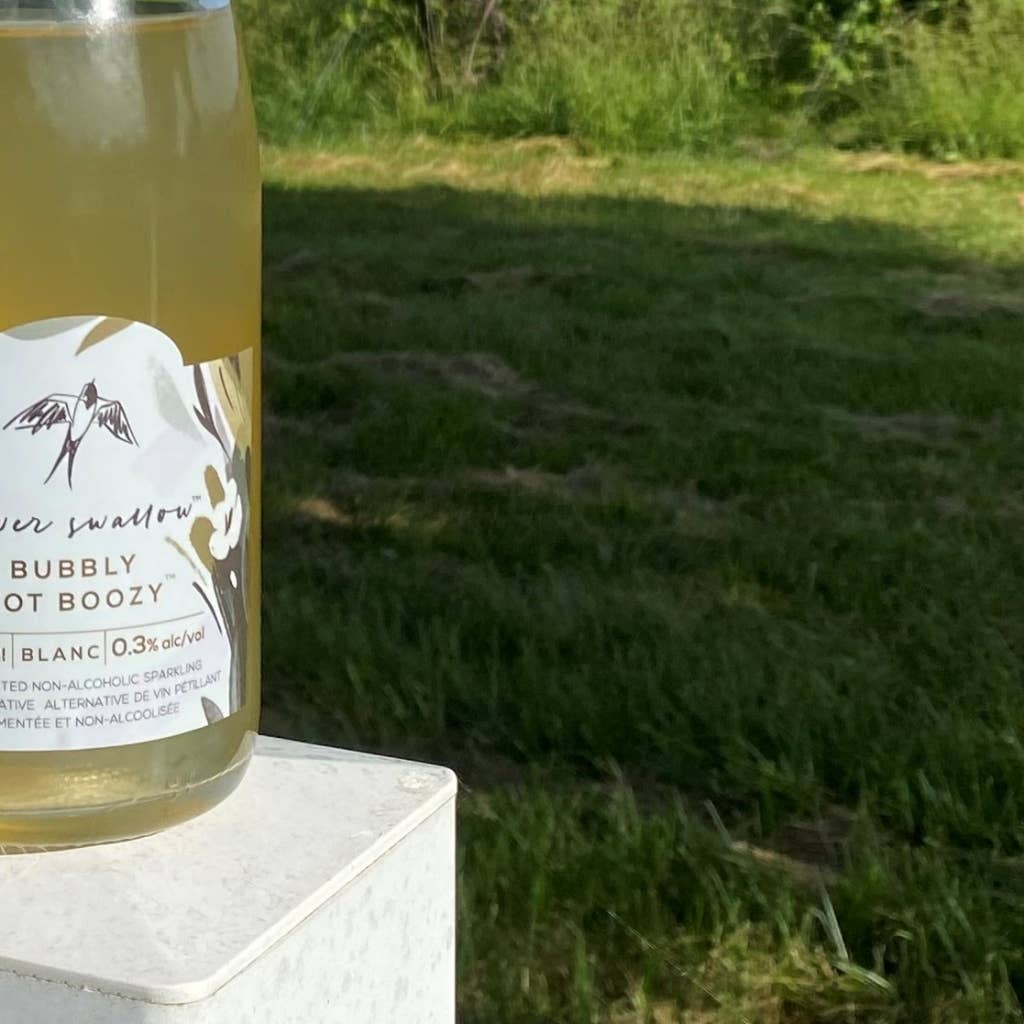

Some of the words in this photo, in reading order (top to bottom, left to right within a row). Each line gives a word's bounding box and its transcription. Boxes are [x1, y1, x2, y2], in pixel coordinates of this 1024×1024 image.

[67, 502, 192, 539] swallow
[10, 553, 136, 580] BUBBLY
[58, 582, 163, 612] BOOZY
[22, 645, 100, 662] BLANC
[111, 634, 159, 657] 0.3%
[161, 626, 205, 650] alc/vol
[32, 673, 140, 692] NON-ALCOHOLIC
[143, 659, 203, 684] SPARKLING
[44, 692, 130, 711] ALTERNATIVE
[133, 690, 150, 703] DE
[153, 687, 172, 700] VIN
[55, 716, 72, 728] ET
